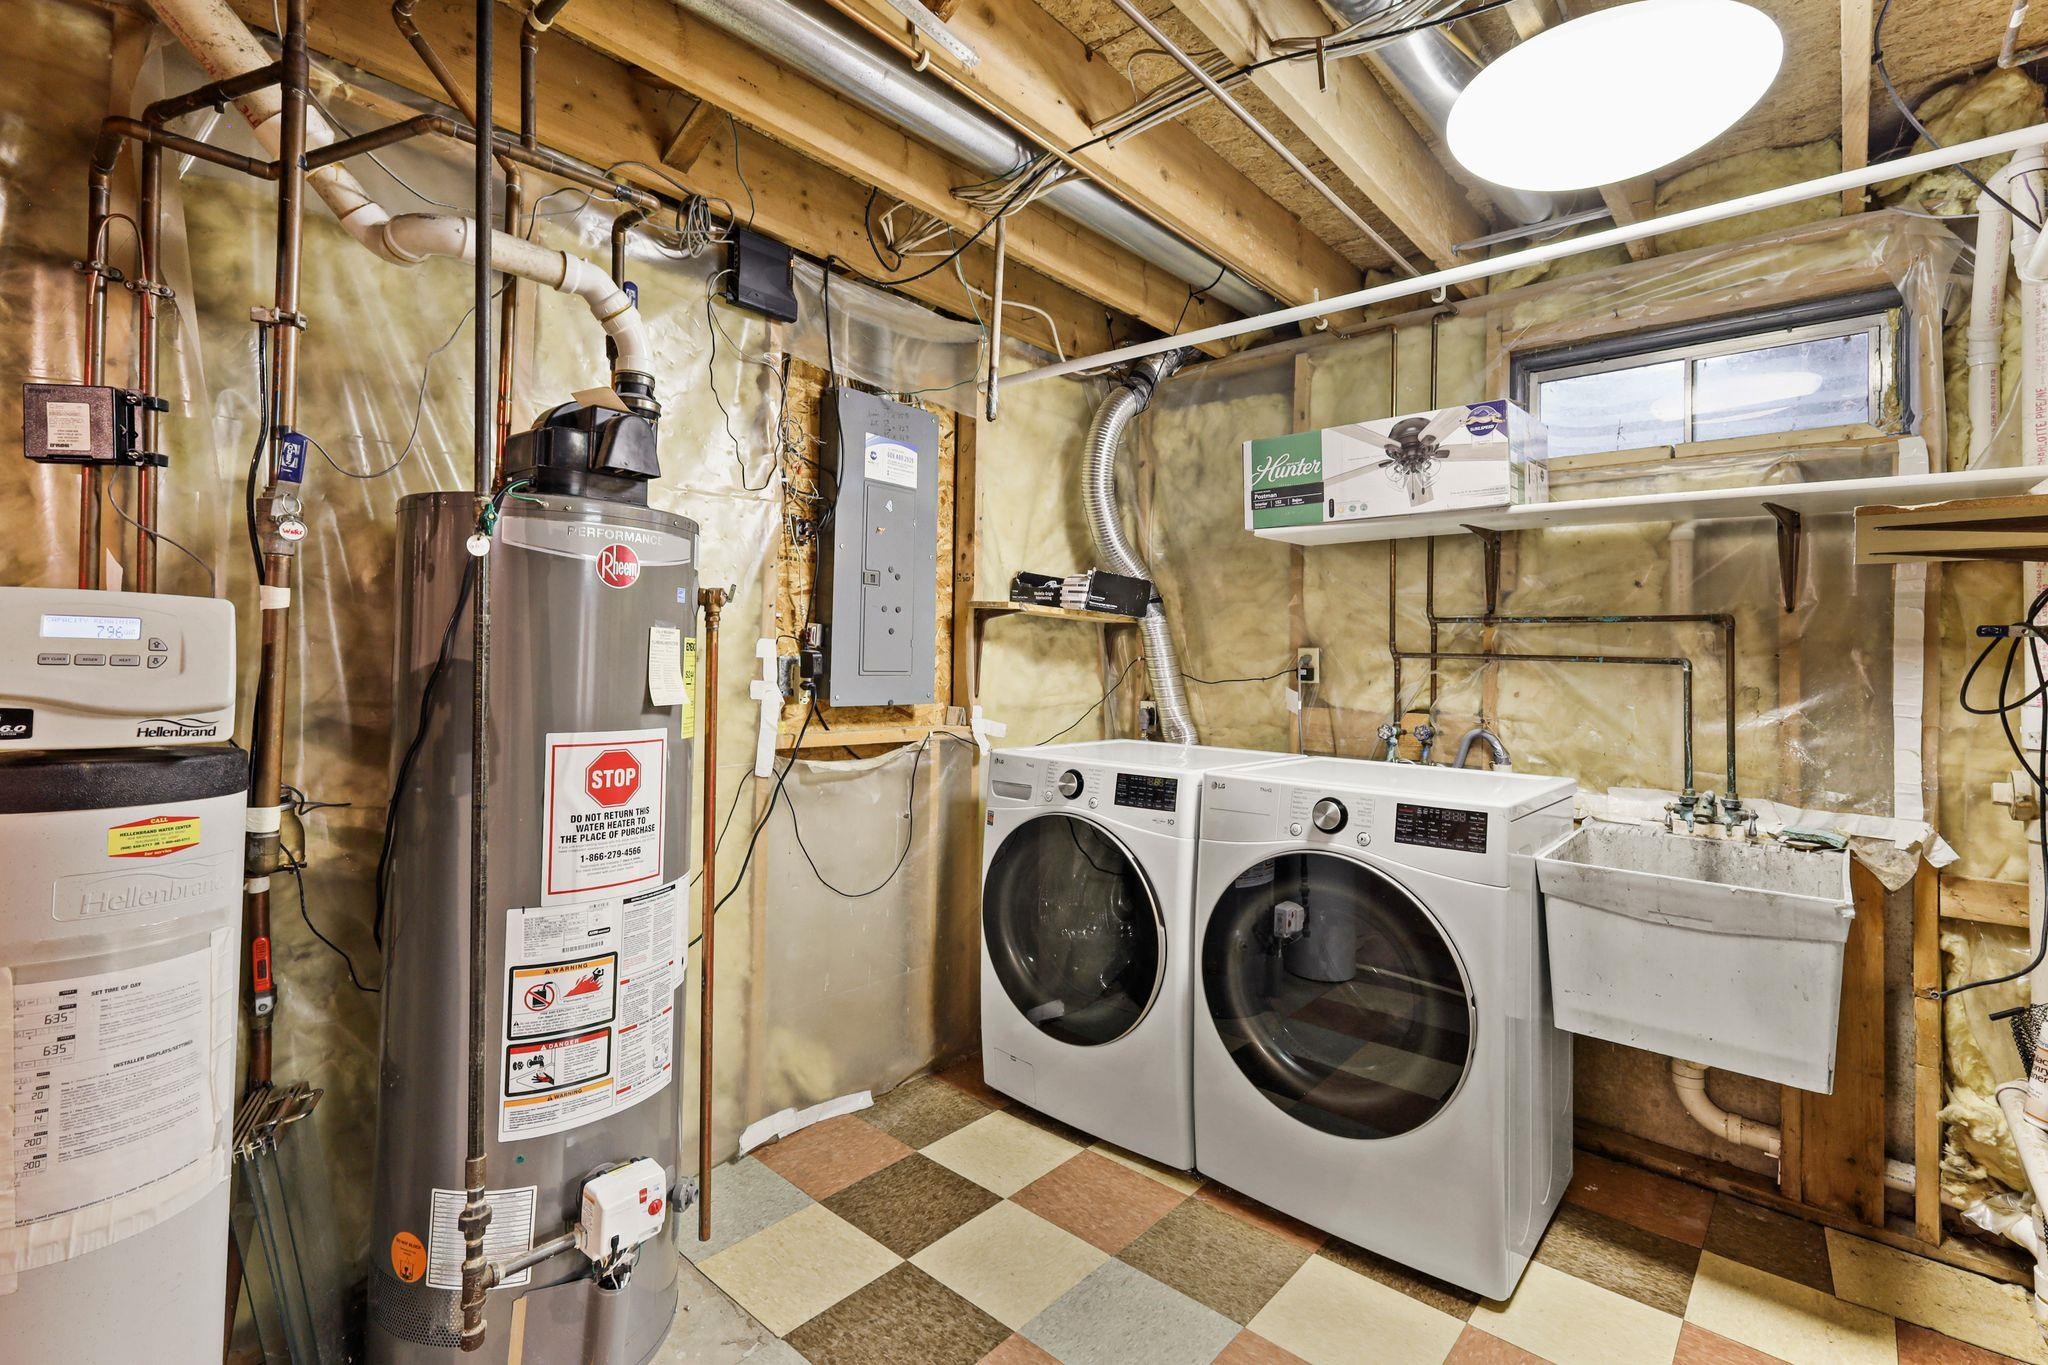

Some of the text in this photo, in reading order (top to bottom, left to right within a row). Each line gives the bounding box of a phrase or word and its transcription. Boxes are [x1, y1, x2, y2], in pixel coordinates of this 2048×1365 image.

[2036, 421, 2048, 464] HARLOTTE
[1251, 453, 1322, 487] Hunter
[568, 526, 664, 546] PERFORMANCE
[602, 545, 637, 582] Rheem
[97, 626, 124, 638] 796
[136, 726, 217, 738] Hellenbrand
[591, 768, 636, 790] STOP
[570, 806, 650, 824] DO NOT RETURN THIS
[576, 822, 604, 832] WATER
[607, 818, 636, 829] HEATER
[120, 829, 158, 837] HELLENBRAND
[560, 835, 577, 844] THE
[580, 832, 606, 842] PLACE
[609, 830, 619, 839] OF
[621, 824, 655, 836] PURCHASE
[581, 846, 641, 863] 1-866-279-4566
[80, 876, 228, 914] Hellenbrand
[552, 963, 588, 973] WARNING
[549, 1039, 580, 1049] DANGER
[113, 1056, 144, 1068] INSTALLER
[32, 1092, 43, 1100] 20
[554, 1089, 583, 1099] WARNING
[24, 1138, 41, 1147] 200
[23, 1160, 40, 1170] 200
